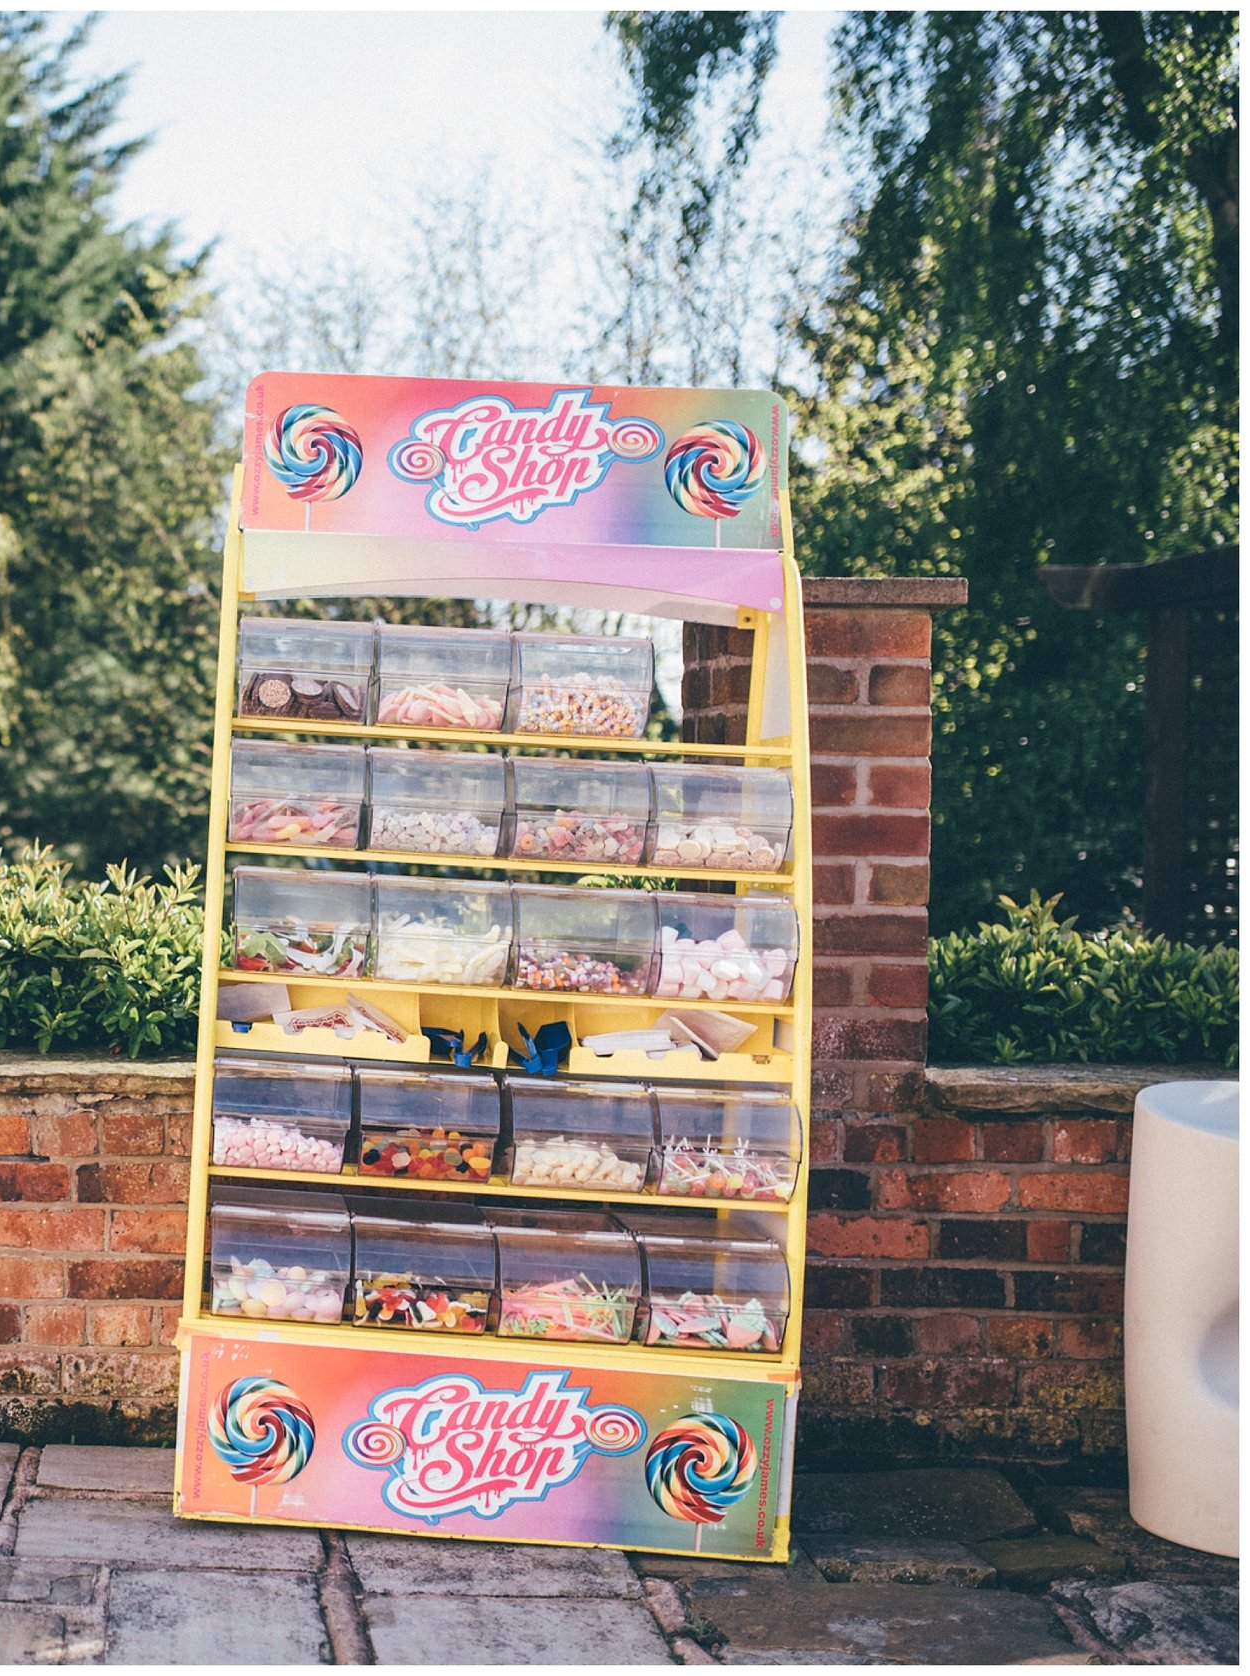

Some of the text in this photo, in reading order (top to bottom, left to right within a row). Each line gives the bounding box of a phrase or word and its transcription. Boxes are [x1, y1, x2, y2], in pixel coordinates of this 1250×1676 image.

[425, 398, 608, 465] Candy
[768, 404, 781, 538] www.ozzyjamesco.uk
[440, 448, 591, 518] Shop
[191, 1352, 210, 1500] www.ozzyjames.co.uk
[384, 1381, 584, 1446] Candy
[396, 1426, 566, 1508] Shop
[756, 1399, 776, 1548] www.ozzyjames.co.uk
